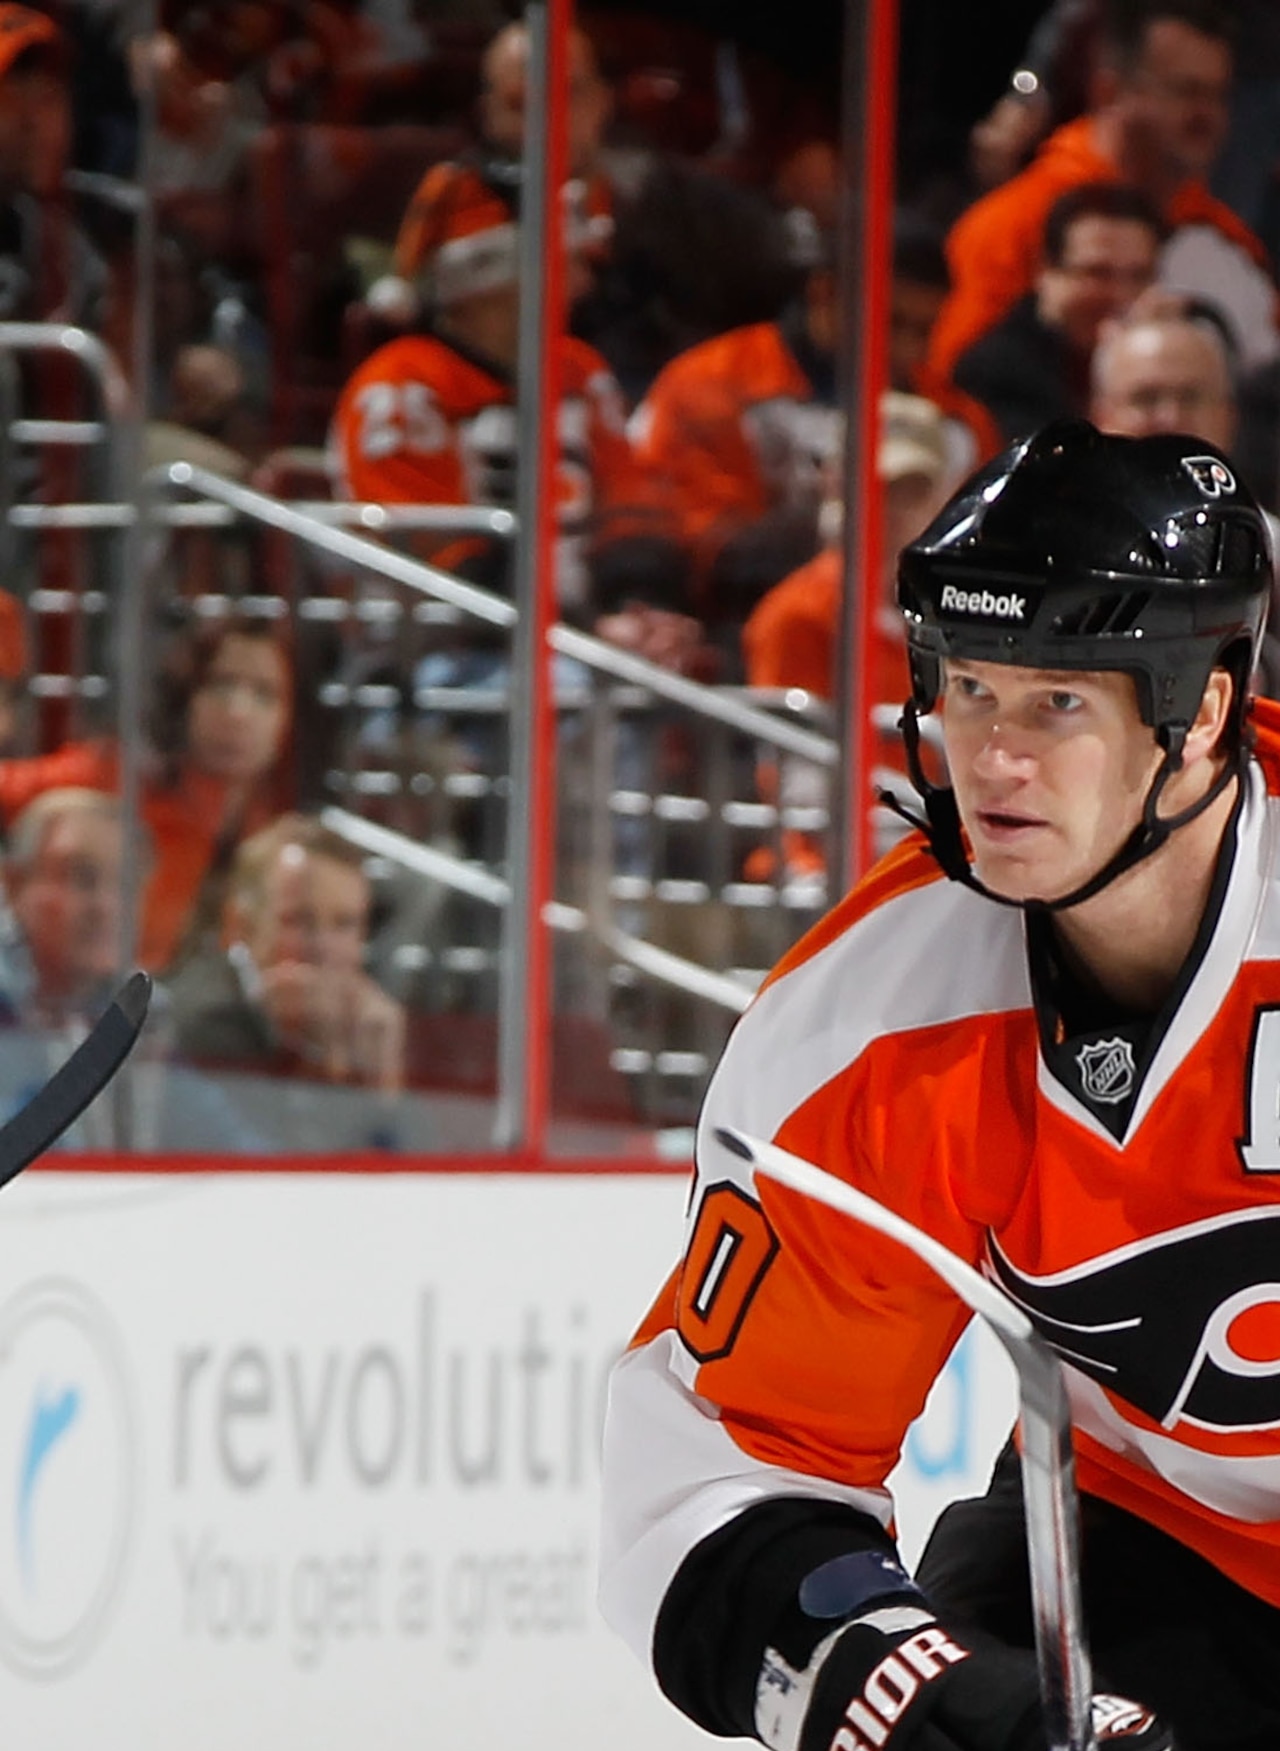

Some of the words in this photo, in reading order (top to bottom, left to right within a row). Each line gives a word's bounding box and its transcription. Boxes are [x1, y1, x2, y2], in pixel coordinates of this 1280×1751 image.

[940, 574, 1027, 620] Reebok
[173, 1286, 612, 1490] revoluti
[173, 1526, 278, 1642] You
[293, 1535, 382, 1672] get
[404, 1553, 434, 1642] a
[446, 1535, 588, 1672] great
